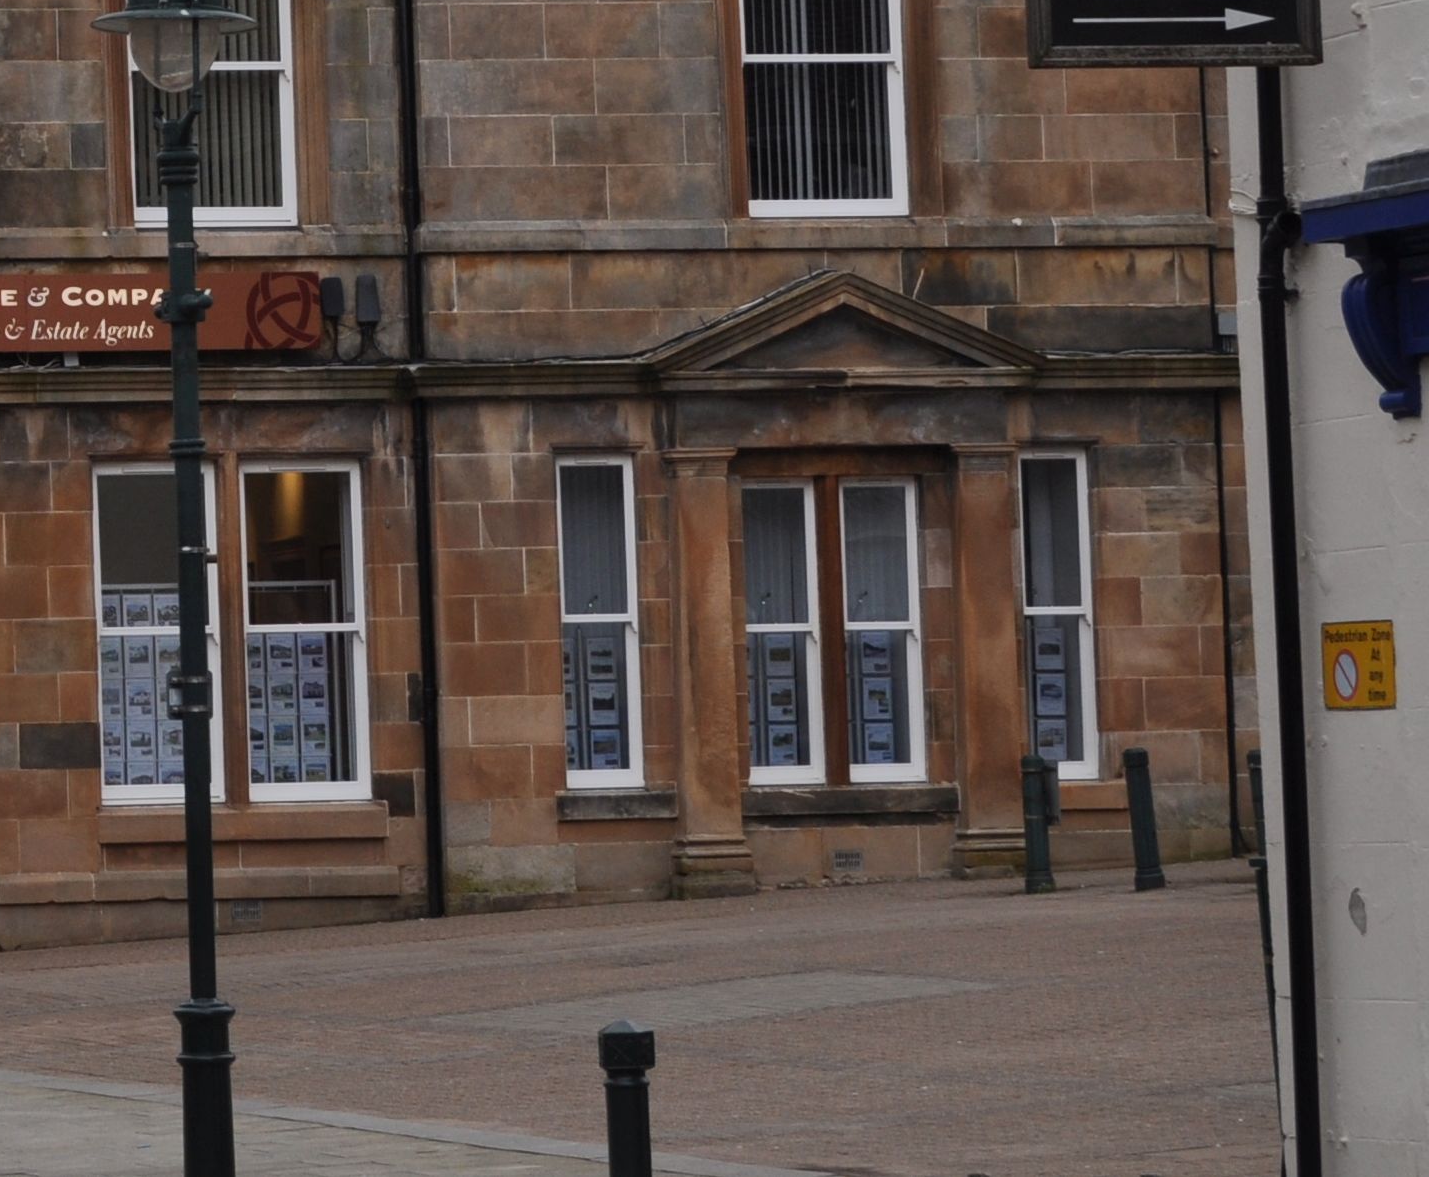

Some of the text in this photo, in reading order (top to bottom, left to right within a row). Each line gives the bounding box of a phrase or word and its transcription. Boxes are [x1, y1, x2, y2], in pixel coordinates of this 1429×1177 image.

[27, 286, 50, 307] &
[4, 318, 26, 340] &
[30, 319, 89, 341] Estate
[93, 317, 155, 346] Agents
